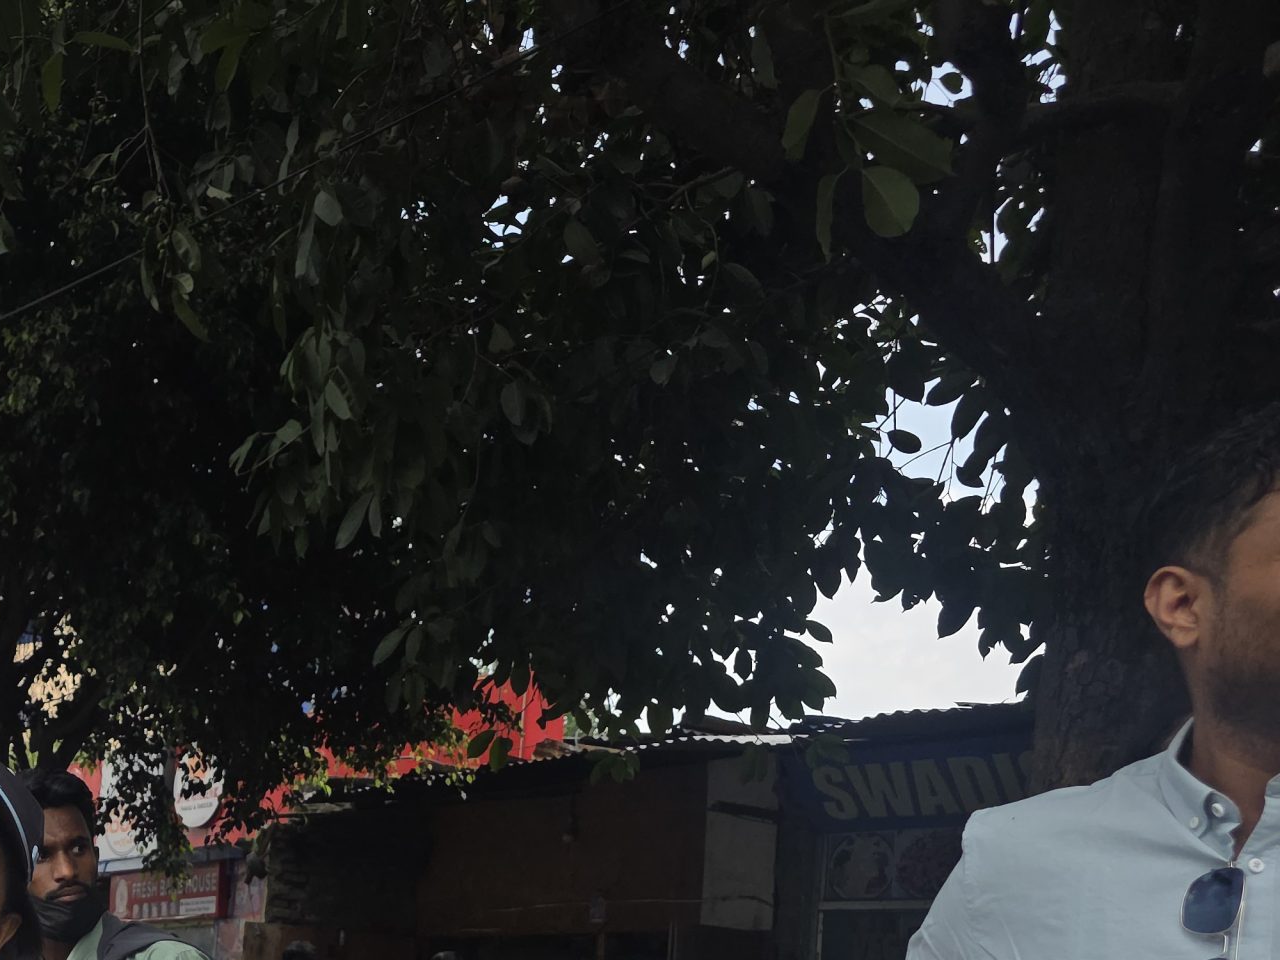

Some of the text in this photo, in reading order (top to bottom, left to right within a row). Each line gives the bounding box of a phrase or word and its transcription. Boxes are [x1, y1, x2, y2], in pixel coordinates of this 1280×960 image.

[131, 873, 217, 898] FRESH BAE HOUSE
